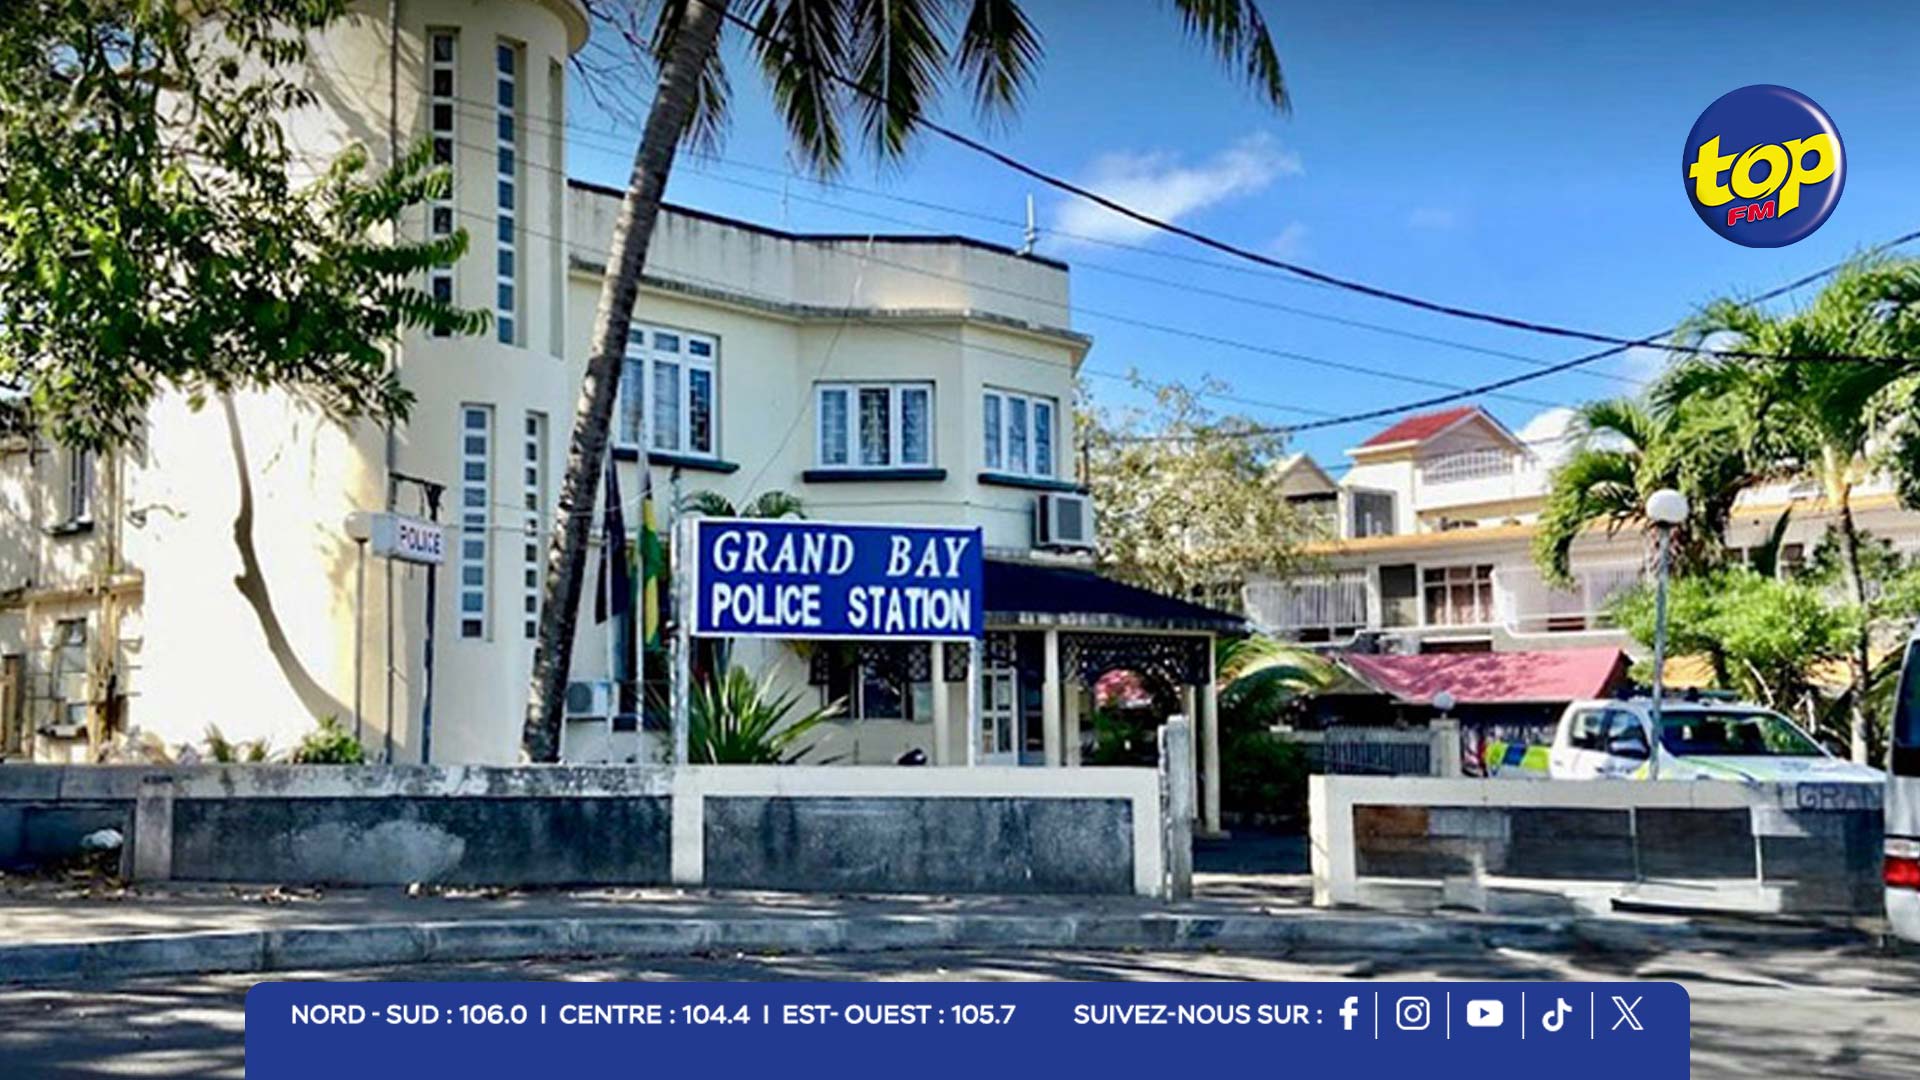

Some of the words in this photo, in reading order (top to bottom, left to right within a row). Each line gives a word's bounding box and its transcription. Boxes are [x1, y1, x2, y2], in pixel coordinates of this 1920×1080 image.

[399, 525, 441, 555] POLICE
[713, 531, 855, 575] GRAND
[886, 535, 970, 578] BAY
[711, 582, 822, 628] POLICE
[847, 586, 972, 633] STATION
